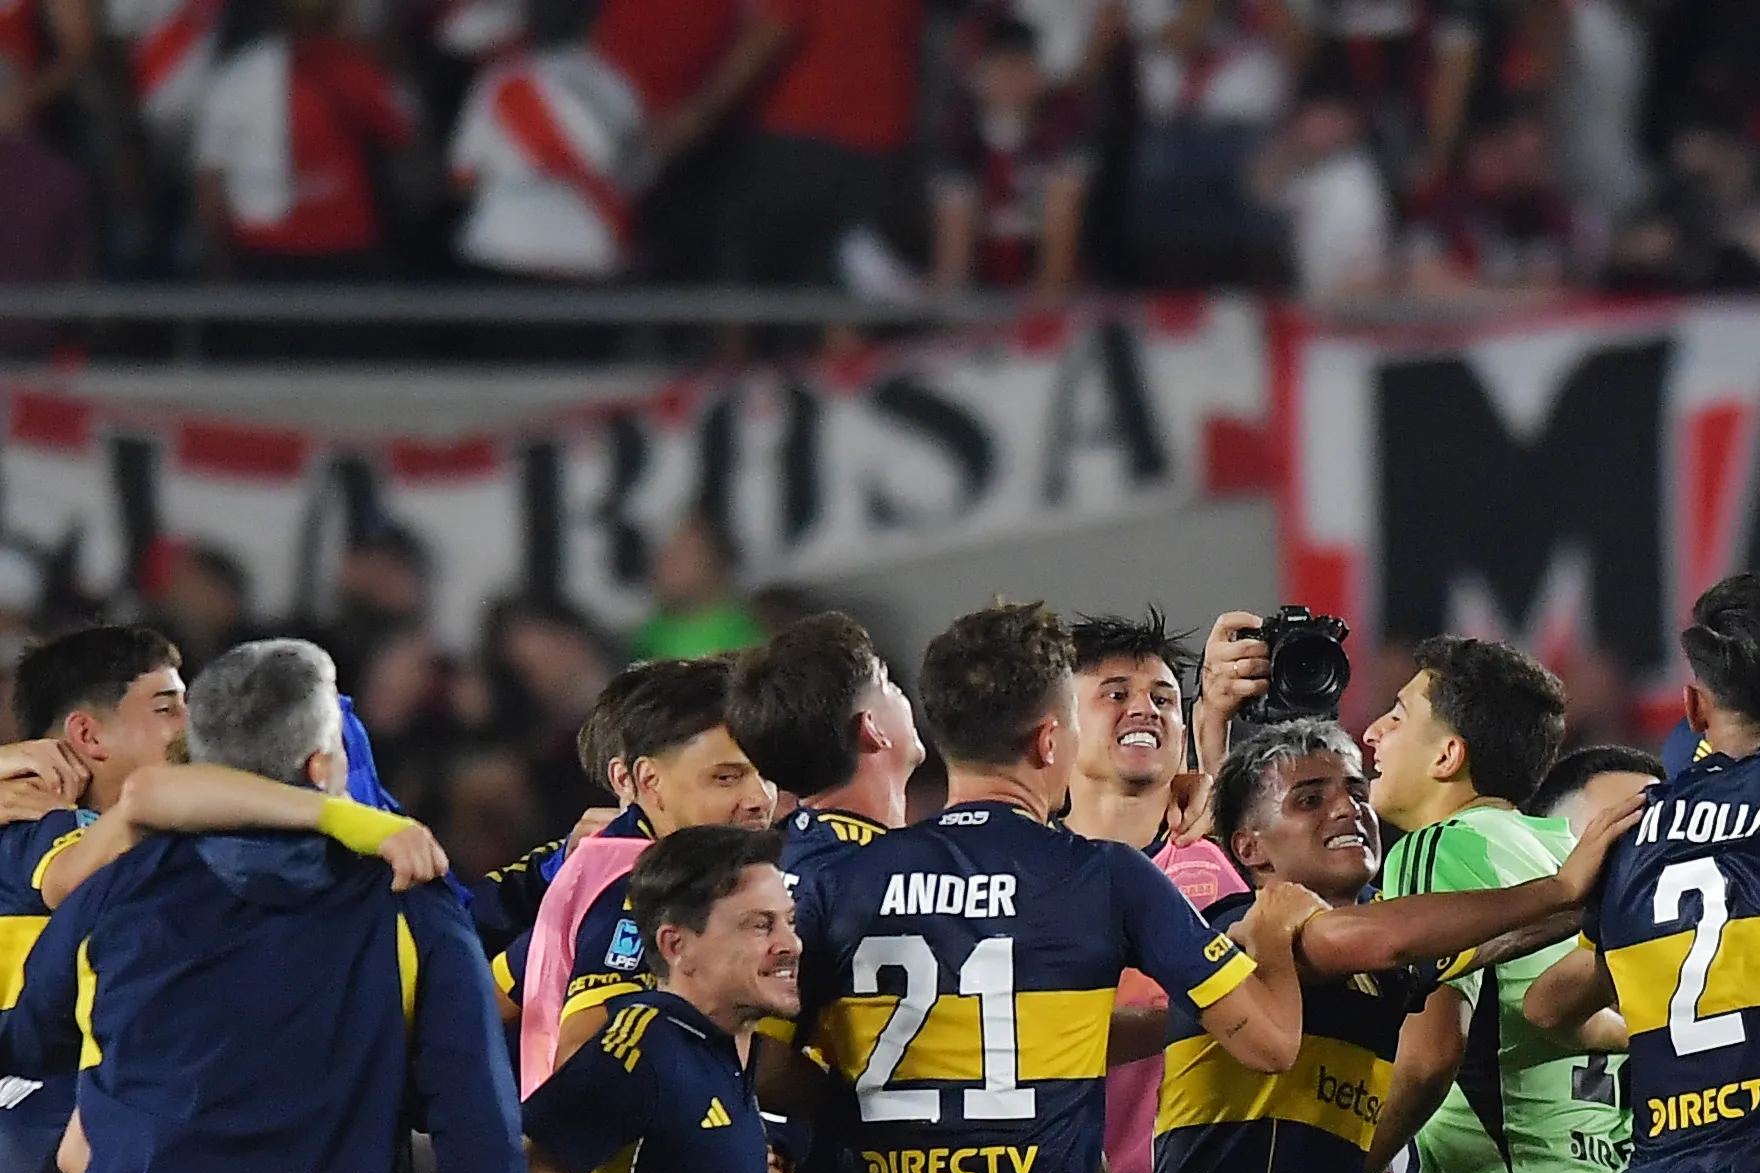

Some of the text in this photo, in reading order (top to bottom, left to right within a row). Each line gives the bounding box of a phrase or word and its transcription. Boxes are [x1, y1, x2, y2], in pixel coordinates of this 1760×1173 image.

[879, 872, 1017, 918] ANDER
[607, 955, 637, 969] LPF
[1653, 856, 1747, 1057] 2
[852, 934, 1036, 1123] 21
[1316, 1064, 1383, 1125] bets
